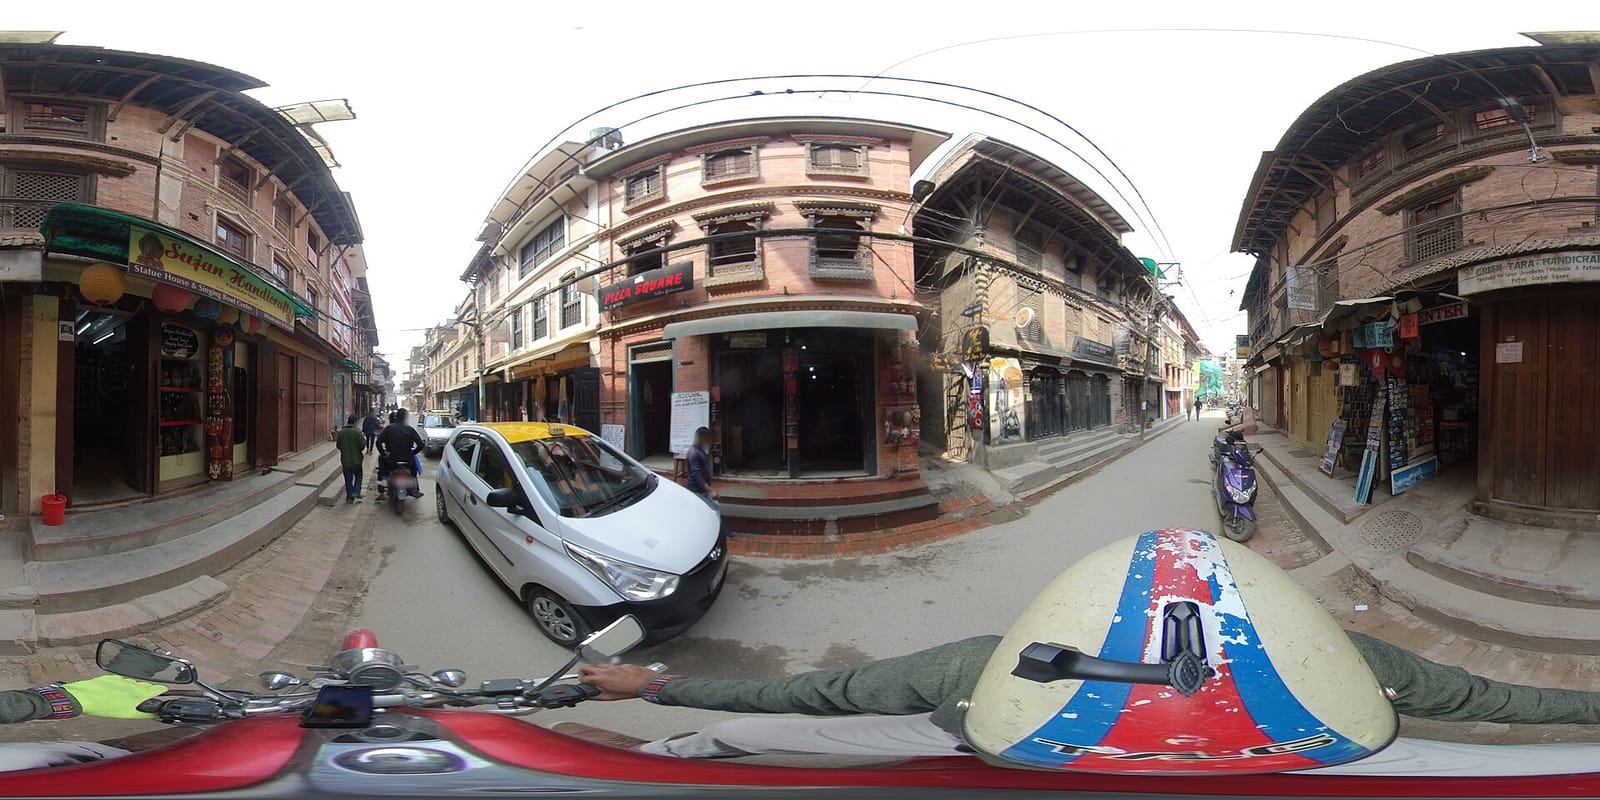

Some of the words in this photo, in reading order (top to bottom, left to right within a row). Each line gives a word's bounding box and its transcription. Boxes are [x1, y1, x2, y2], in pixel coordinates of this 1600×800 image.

[165, 242, 224, 279] Sujan
[1476, 264, 1502, 275] GREEN
[1508, 259, 1535, 270] TARA
[134, 264, 163, 278] Statue
[164, 270, 190, 287] House
[191, 281, 197, 290] &
[198, 283, 223, 301] Singing
[222, 292, 237, 306] Bowl
[236, 298, 253, 312] Center
[604, 287, 631, 305] PIZZA
[634, 272, 684, 296] SQUARE
